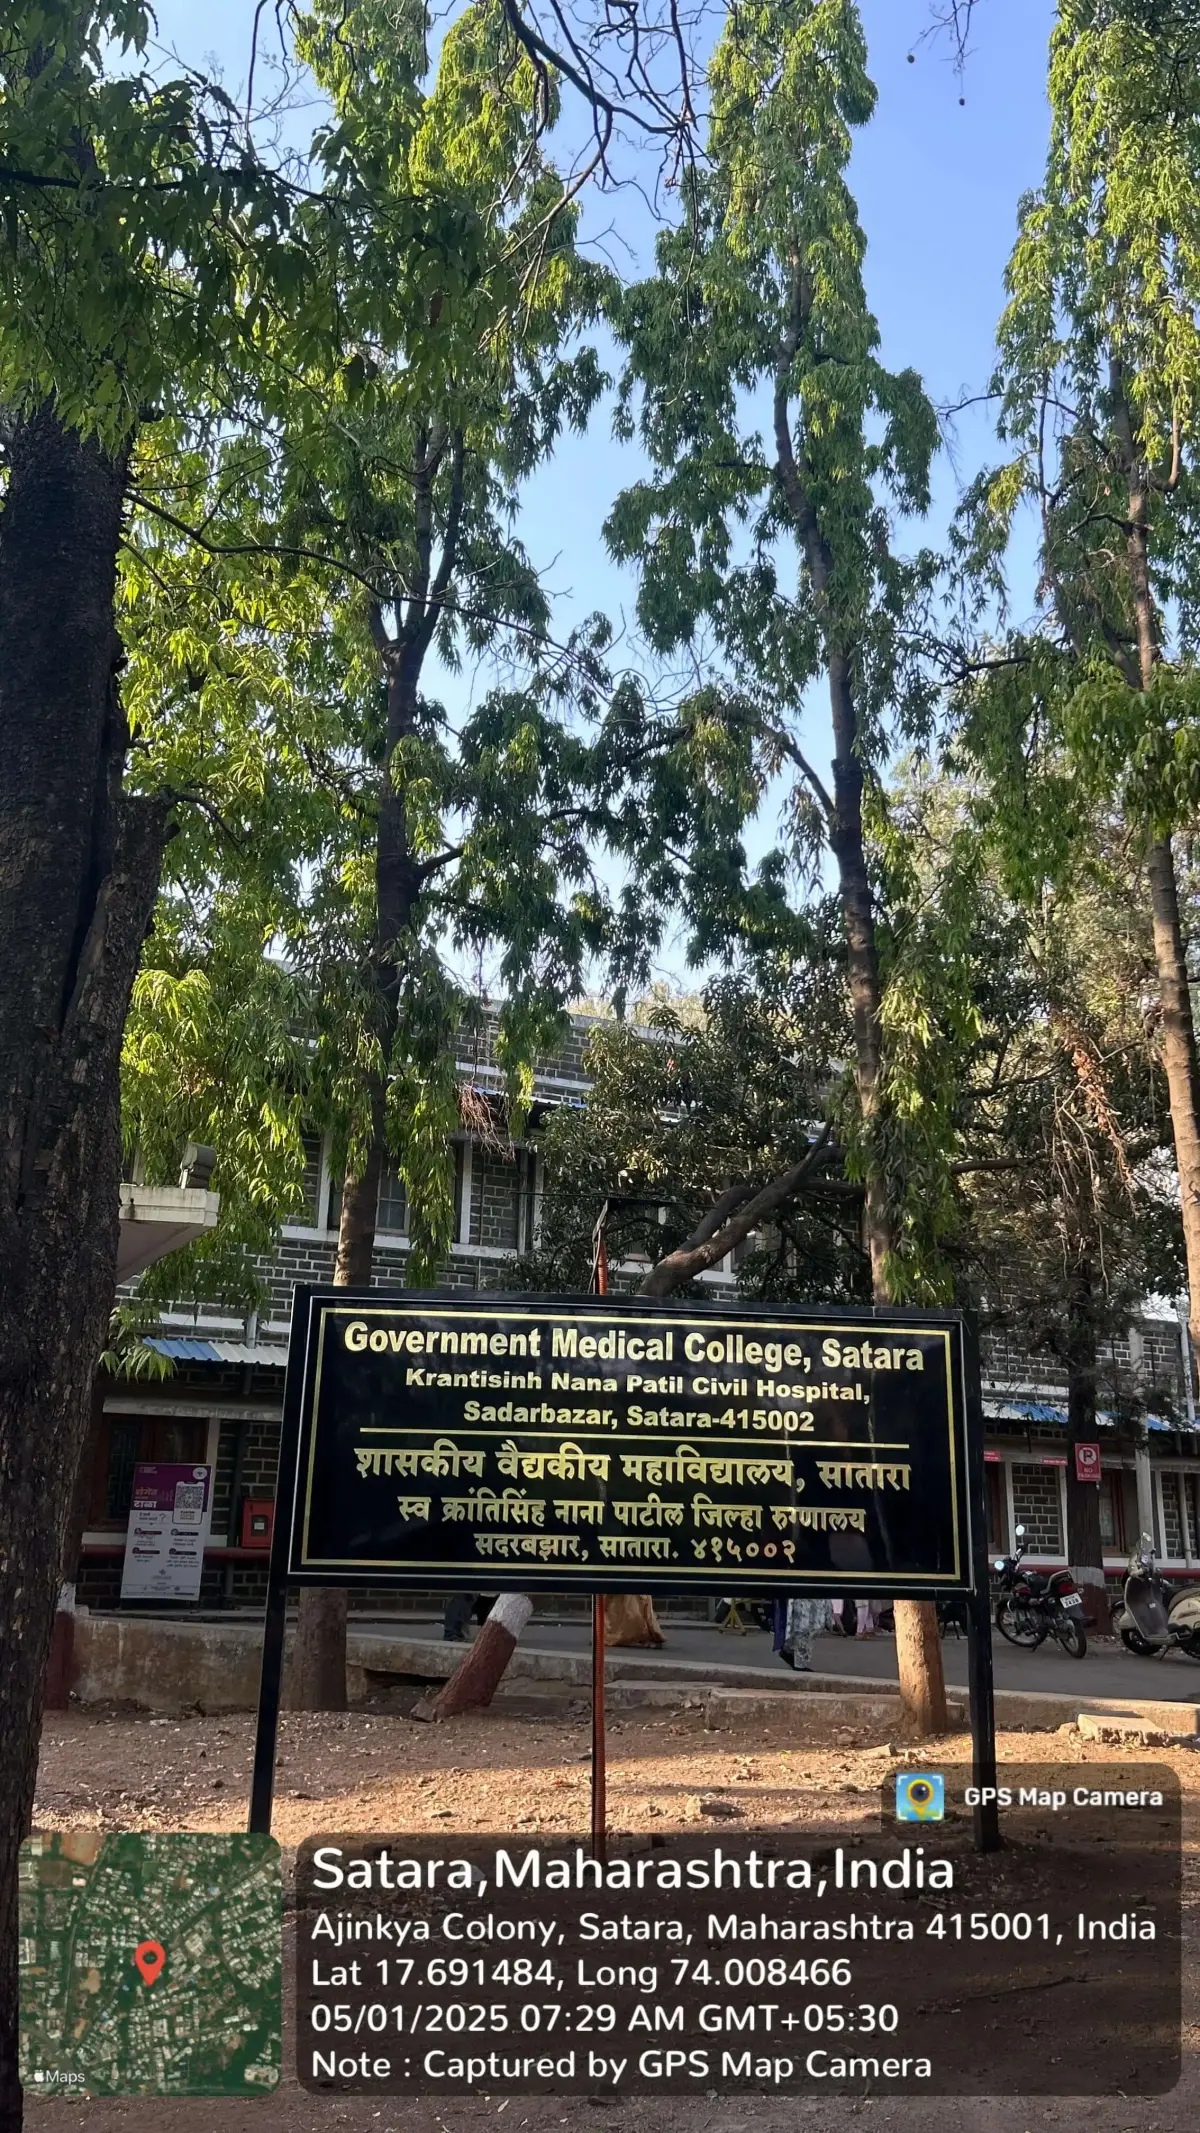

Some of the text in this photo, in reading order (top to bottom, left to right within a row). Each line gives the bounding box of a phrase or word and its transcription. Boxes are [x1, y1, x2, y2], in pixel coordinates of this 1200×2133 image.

[344, 1321, 924, 1373] Government Medical College, Satara
[406, 1368, 870, 1404] Krantisinh Nana Patil Civil Hospital,
[463, 1400, 815, 1431] Sadarbazar, Satara-415002
[354, 1438, 911, 1493] शासकीय वैद्यकीय महाविद्यालय, सातारा
[397, 1486, 866, 1533] स्व क्रांतिसिंह नाना पाटील जिल्हा रुग्णालय
[473, 1533, 796, 1563] सदरबझार, सातारा. ४१५००२
